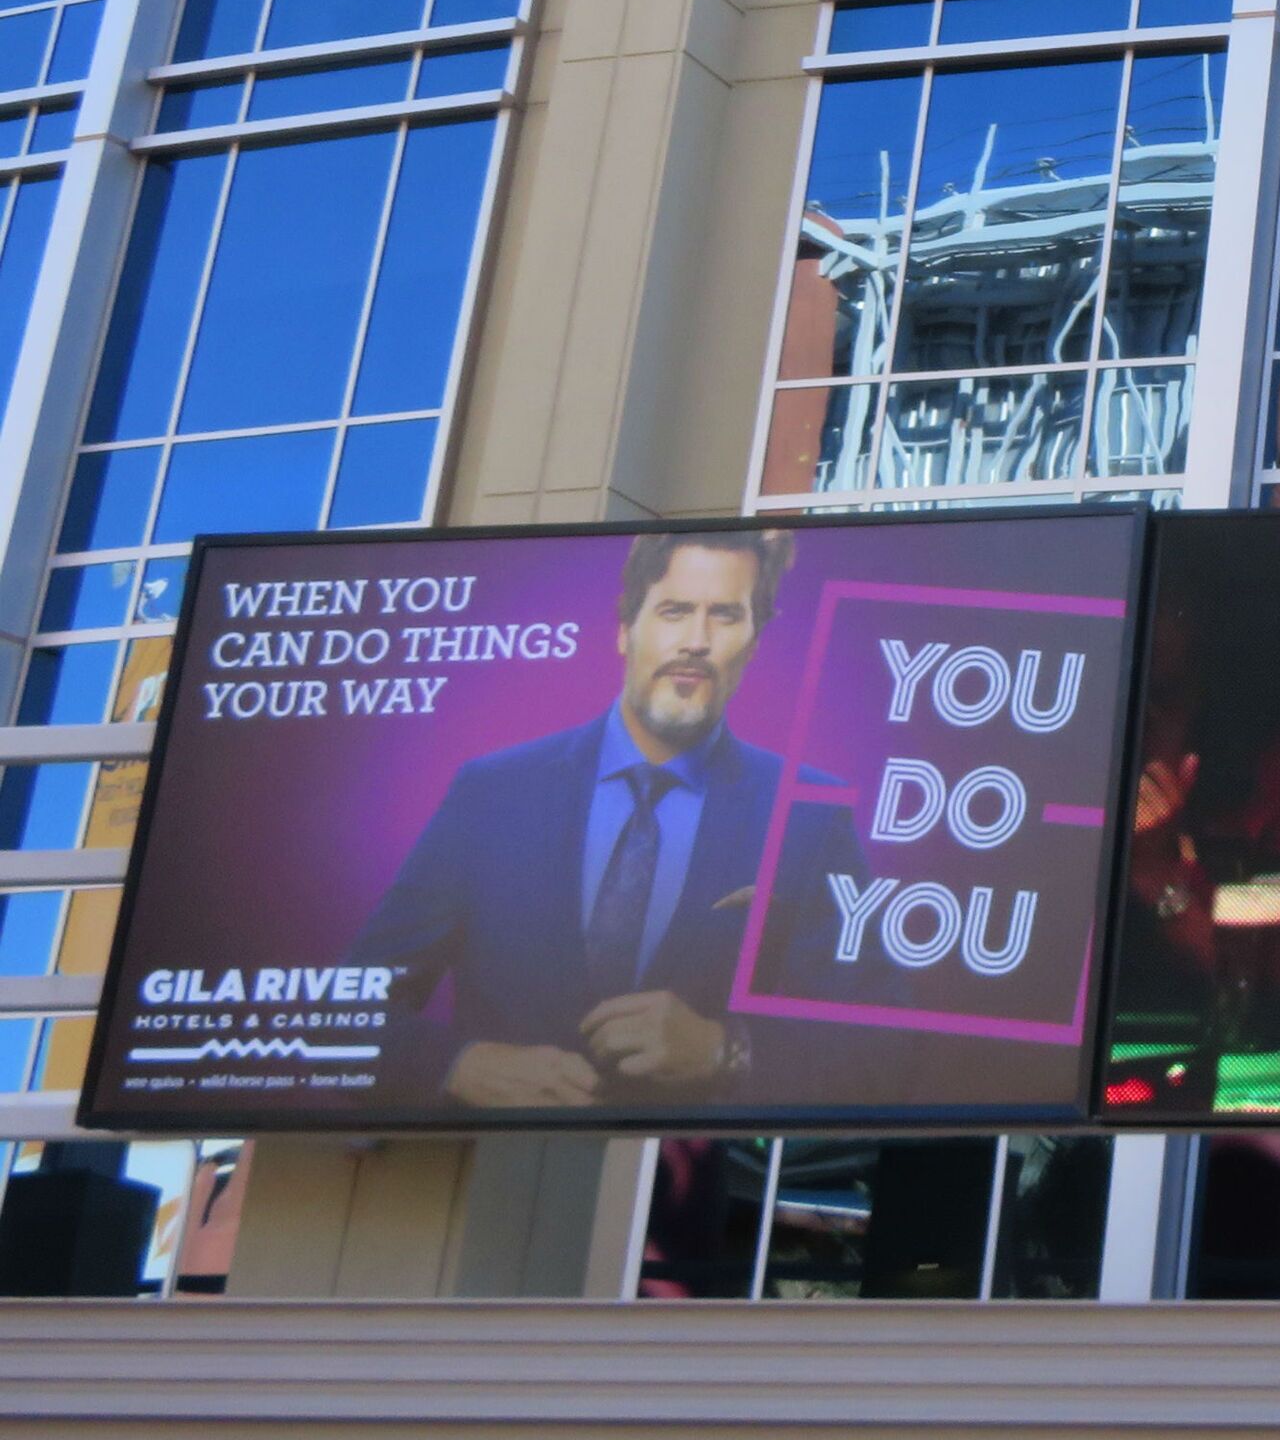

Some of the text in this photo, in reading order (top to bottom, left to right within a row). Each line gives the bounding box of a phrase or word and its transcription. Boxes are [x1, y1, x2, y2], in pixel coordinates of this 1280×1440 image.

[224, 576, 476, 618] WHEN YOU
[211, 623, 580, 669] CAN DO THINGS
[205, 678, 448, 719] YOUR WAY
[880, 639, 1085, 732] YOU
[870, 758, 1027, 848] DO
[827, 873, 1038, 975] YOU
[142, 967, 393, 1003] GILA RIVER
[134, 1012, 386, 1029] HOTELS & CASINOS
[200, 1074, 225, 1086] wild
[227, 1074, 264, 1086] horse
[265, 1076, 294, 1088] pass
[341, 1073, 376, 1085] butte
